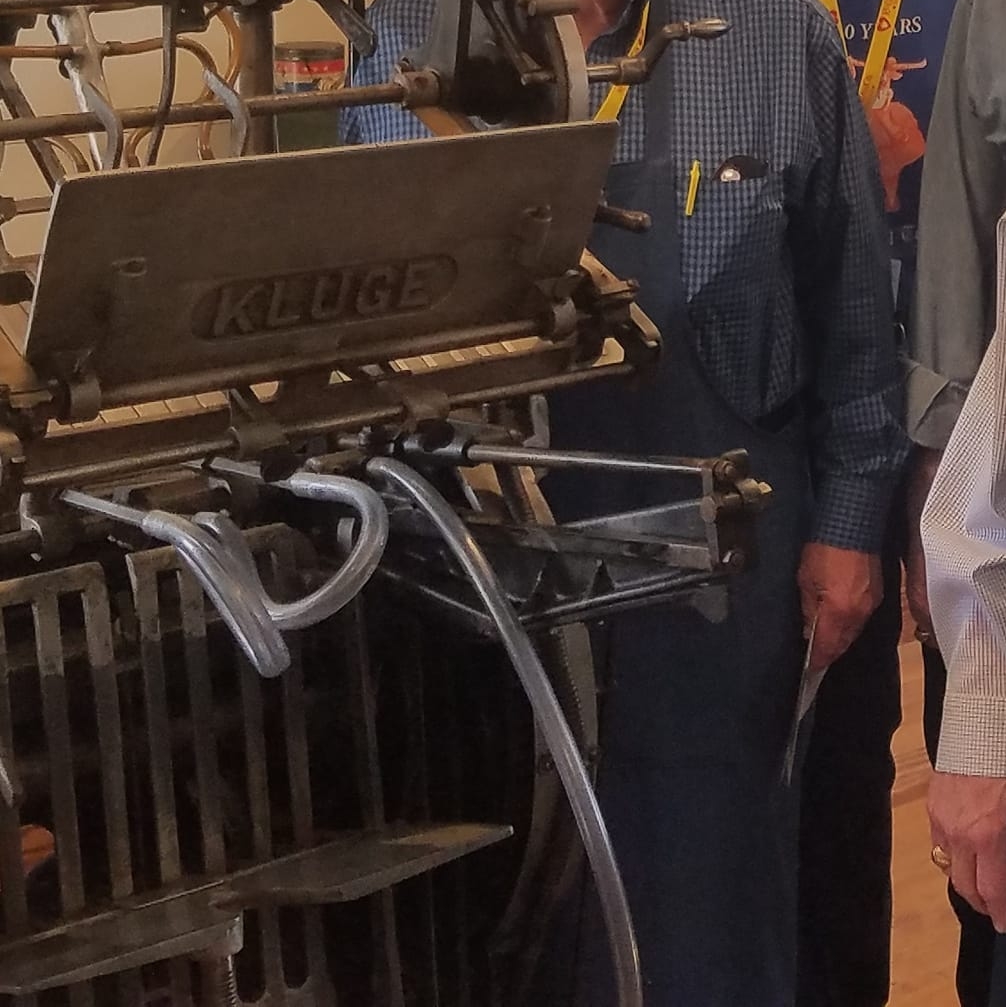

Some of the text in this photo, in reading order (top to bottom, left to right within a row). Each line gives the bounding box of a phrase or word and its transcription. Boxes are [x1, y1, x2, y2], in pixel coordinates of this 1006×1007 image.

[844, 16, 922, 40] 0 YRS
[213, 261, 437, 338] KLUGE
